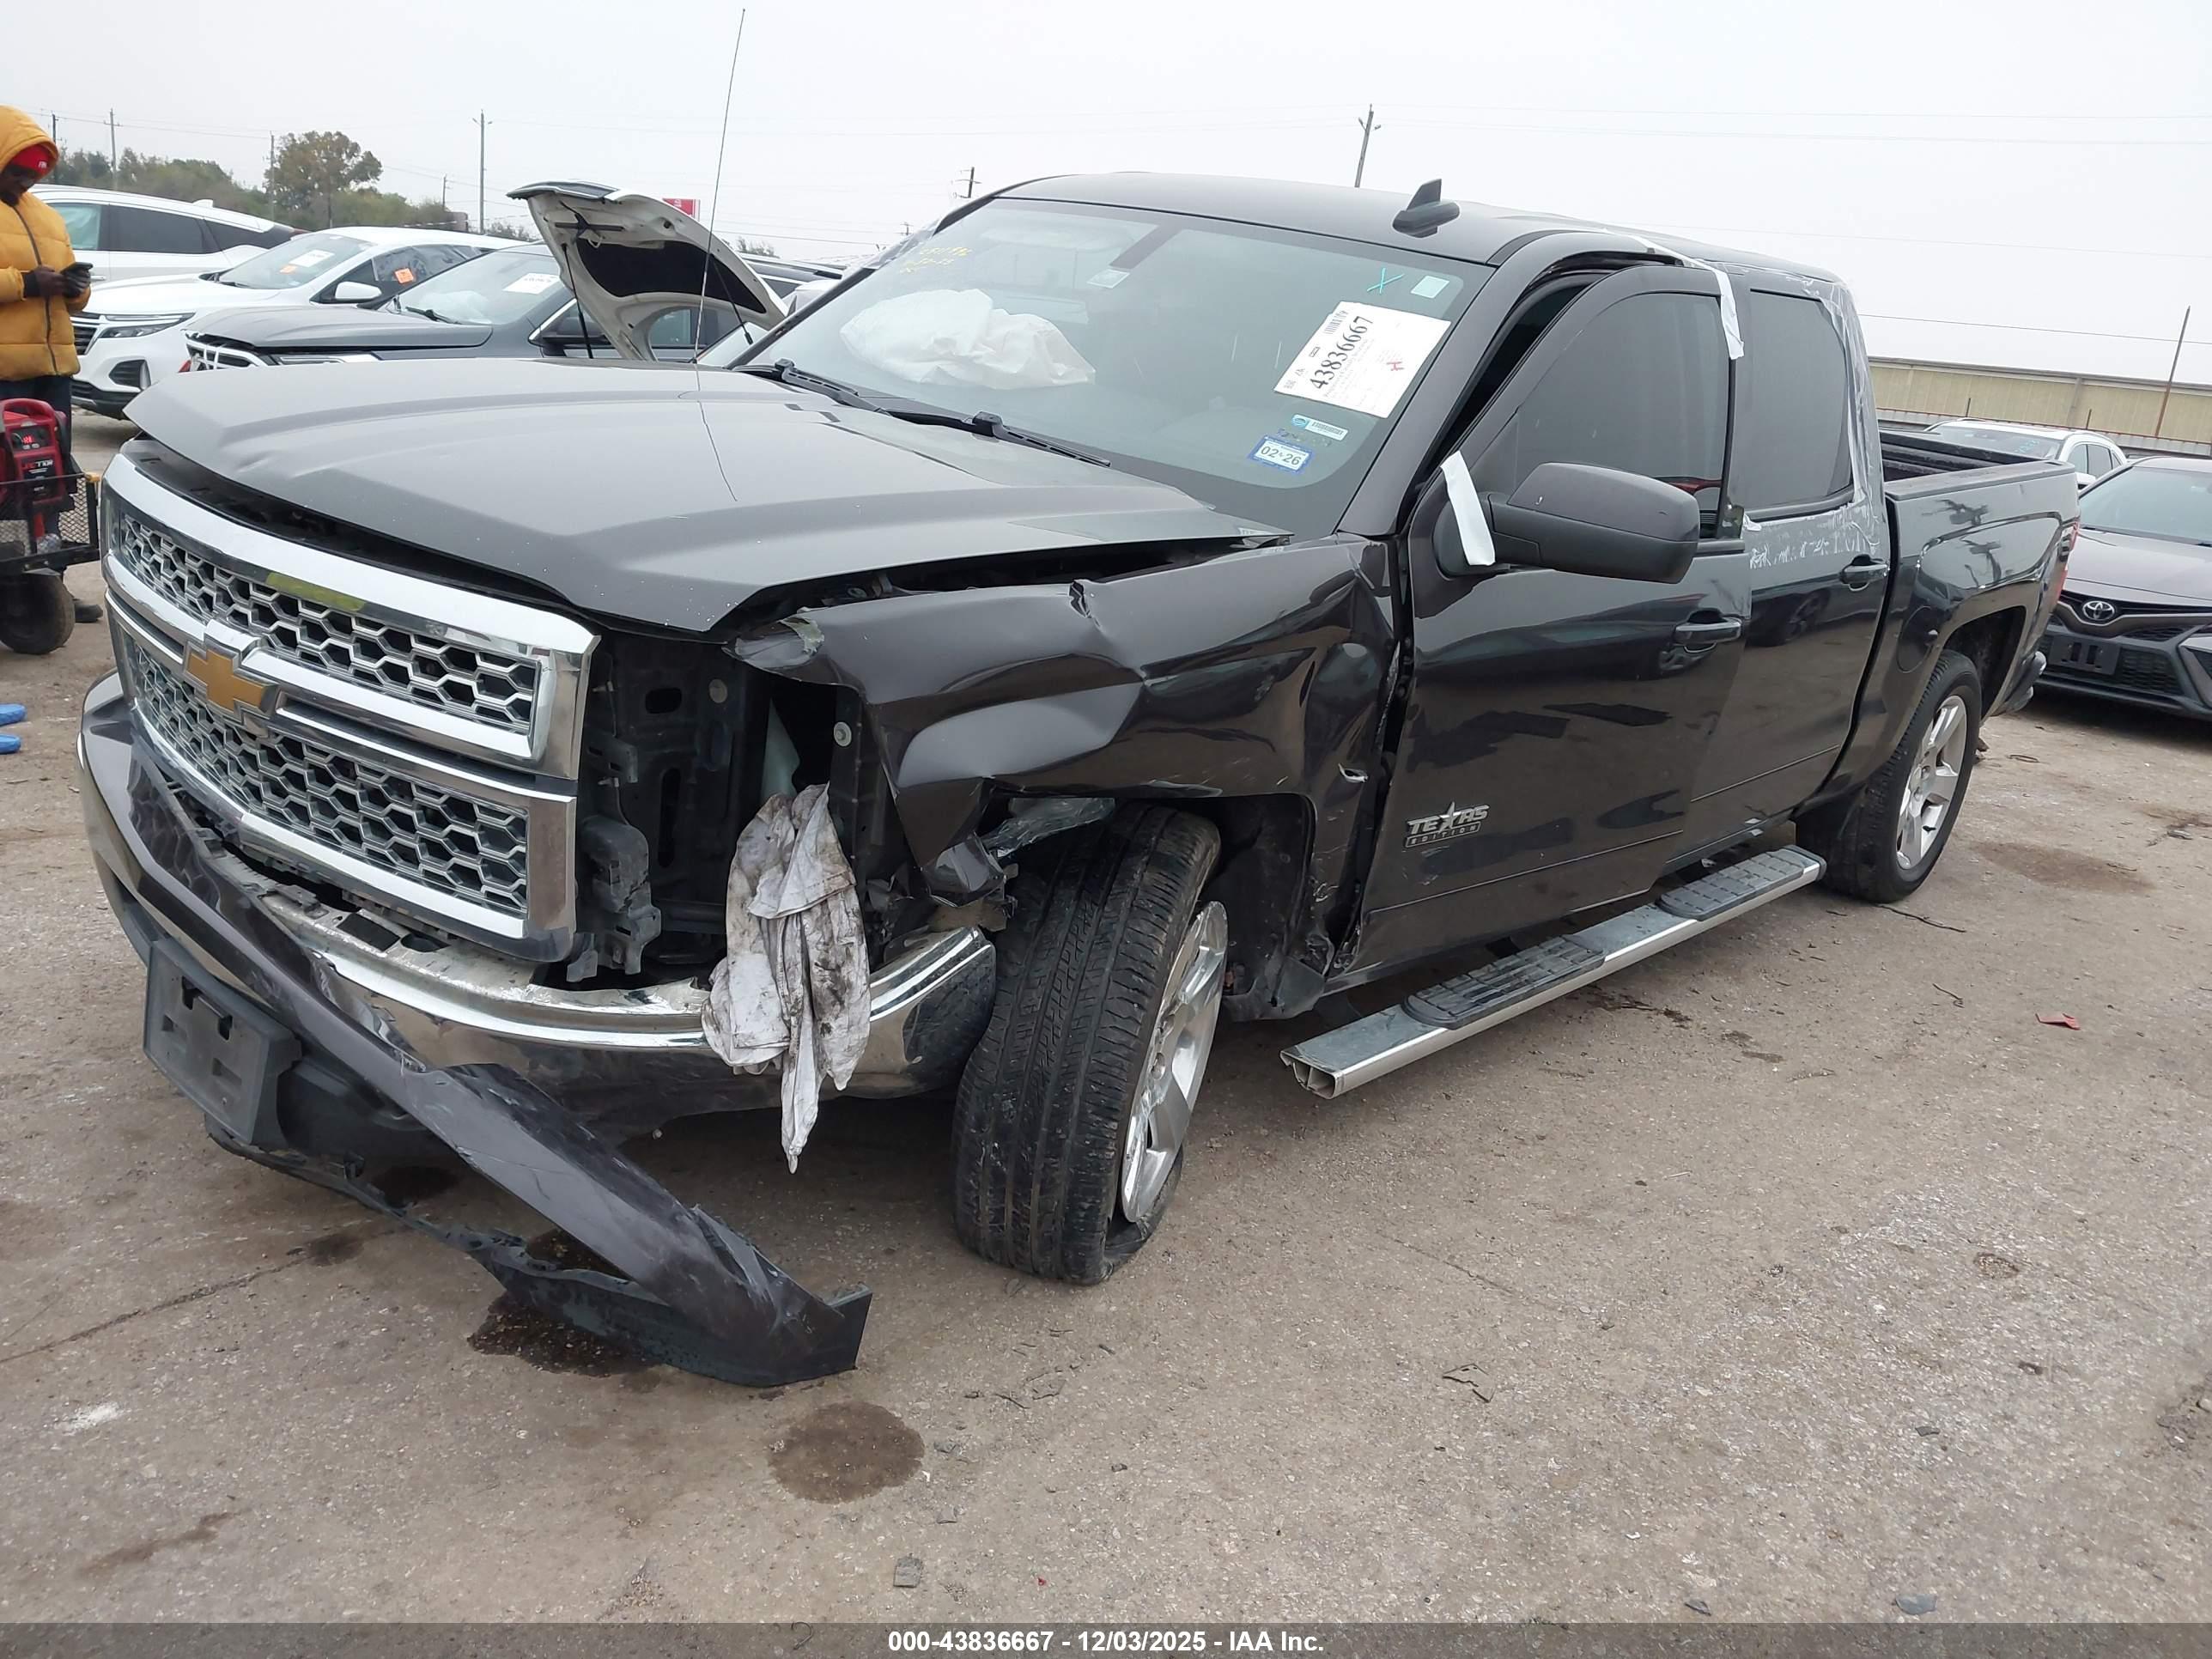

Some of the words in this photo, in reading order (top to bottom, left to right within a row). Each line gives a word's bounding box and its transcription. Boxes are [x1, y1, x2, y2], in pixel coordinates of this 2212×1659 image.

[1310, 315, 1374, 389] 43836667
[1261, 446, 1279, 459] 02
[1283, 453, 1302, 466] 26
[1407, 802, 1490, 835] TEXAS
